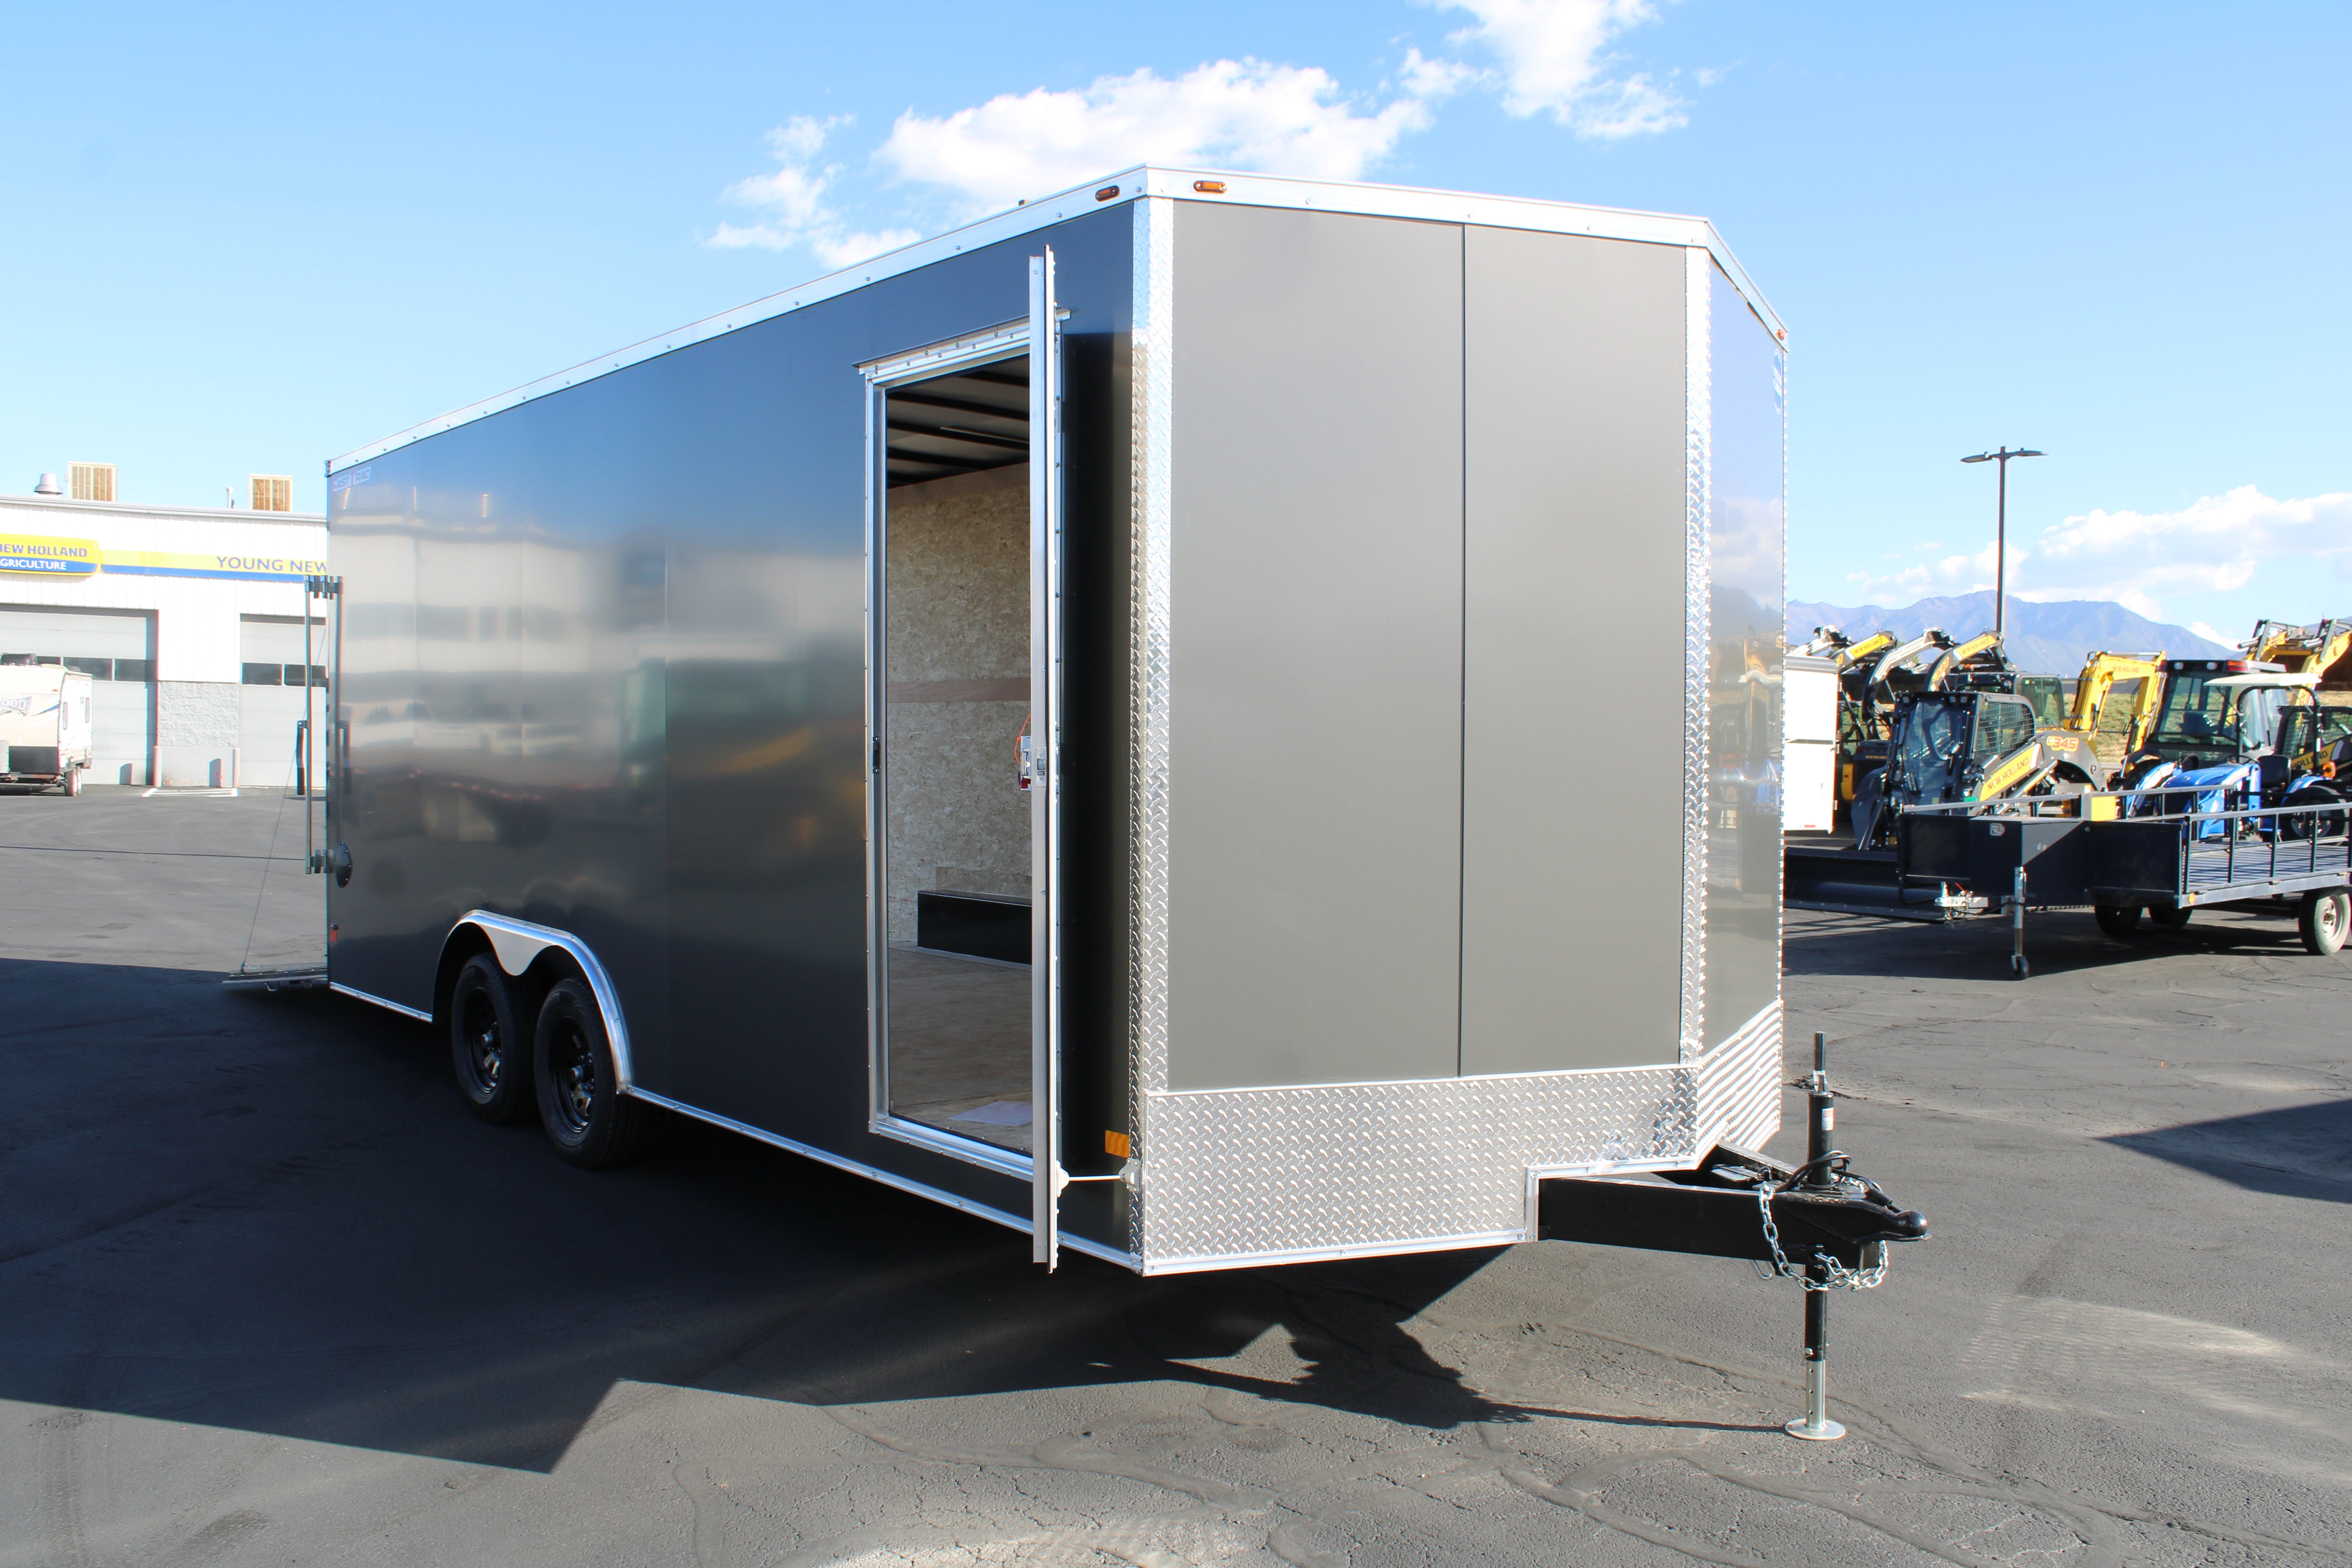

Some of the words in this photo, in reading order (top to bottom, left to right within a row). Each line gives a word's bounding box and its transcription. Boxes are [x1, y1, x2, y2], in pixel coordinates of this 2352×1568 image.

[28, 545, 88, 557] HOLLAND
[0, 558, 67, 570] GRICULTURE
[216, 556, 285, 571] YOUNG
[2047, 736, 2079, 751] C345
[1987, 779, 2001, 791] NEW
[2002, 757, 2029, 781] HOLLAND
